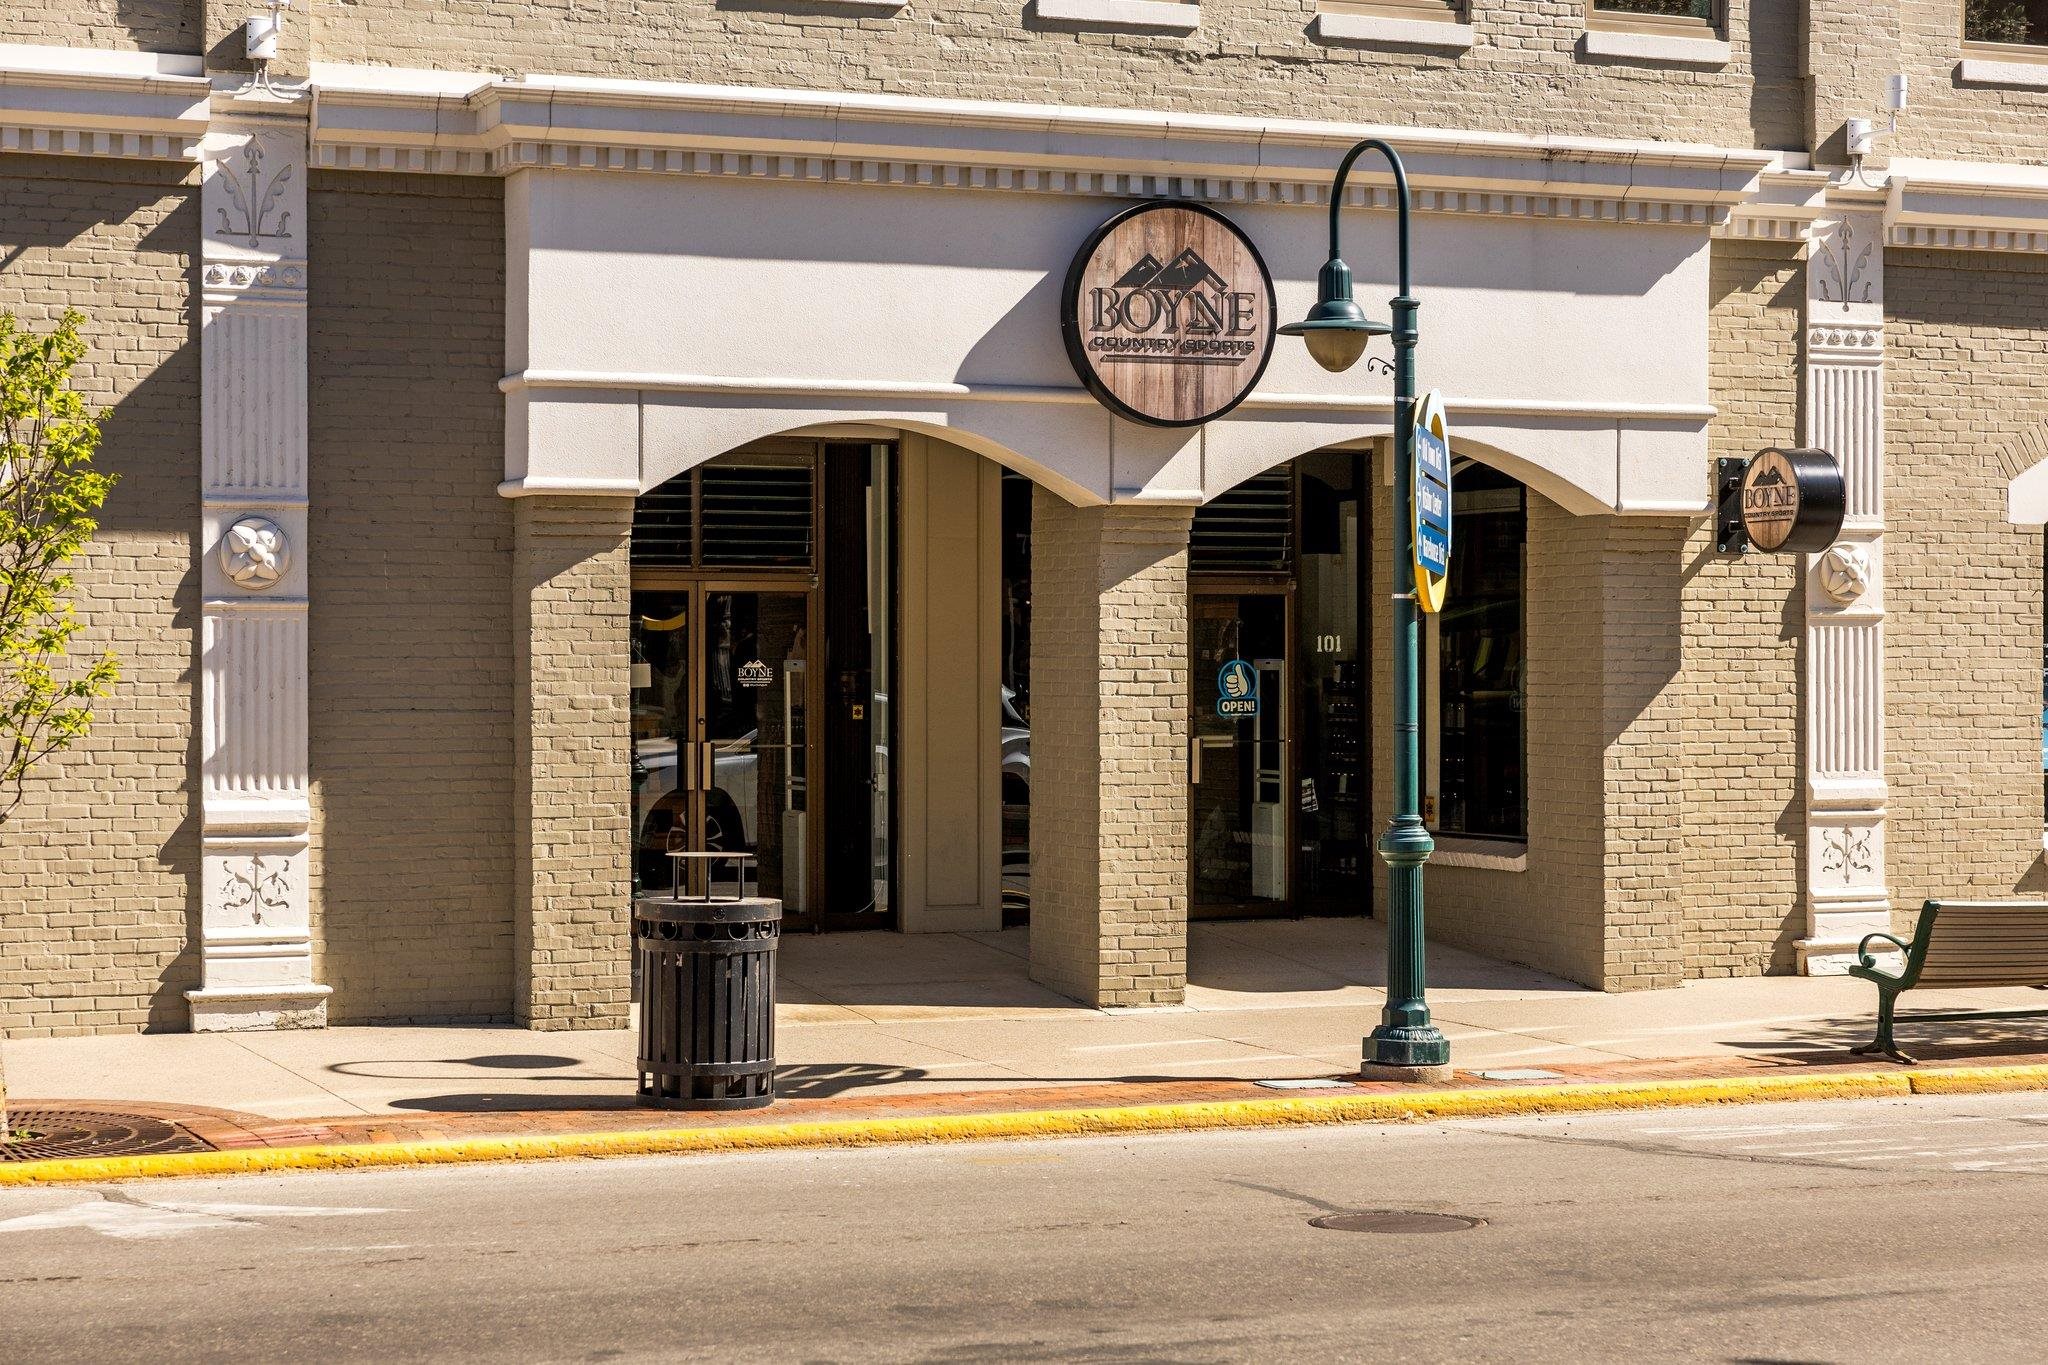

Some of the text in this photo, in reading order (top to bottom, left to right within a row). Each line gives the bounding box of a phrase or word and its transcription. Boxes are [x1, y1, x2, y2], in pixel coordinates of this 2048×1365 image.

[1089, 287, 1257, 336] BOYNE
[1089, 336, 1255, 355] COUNTRY SPORTS
[1744, 486, 1795, 508] BOYNE
[1744, 511, 1770, 519] COUNTRY
[1316, 635, 1342, 652] 101
[738, 667, 773, 677] BOYNE
[1221, 701, 1255, 712] OPEN!
